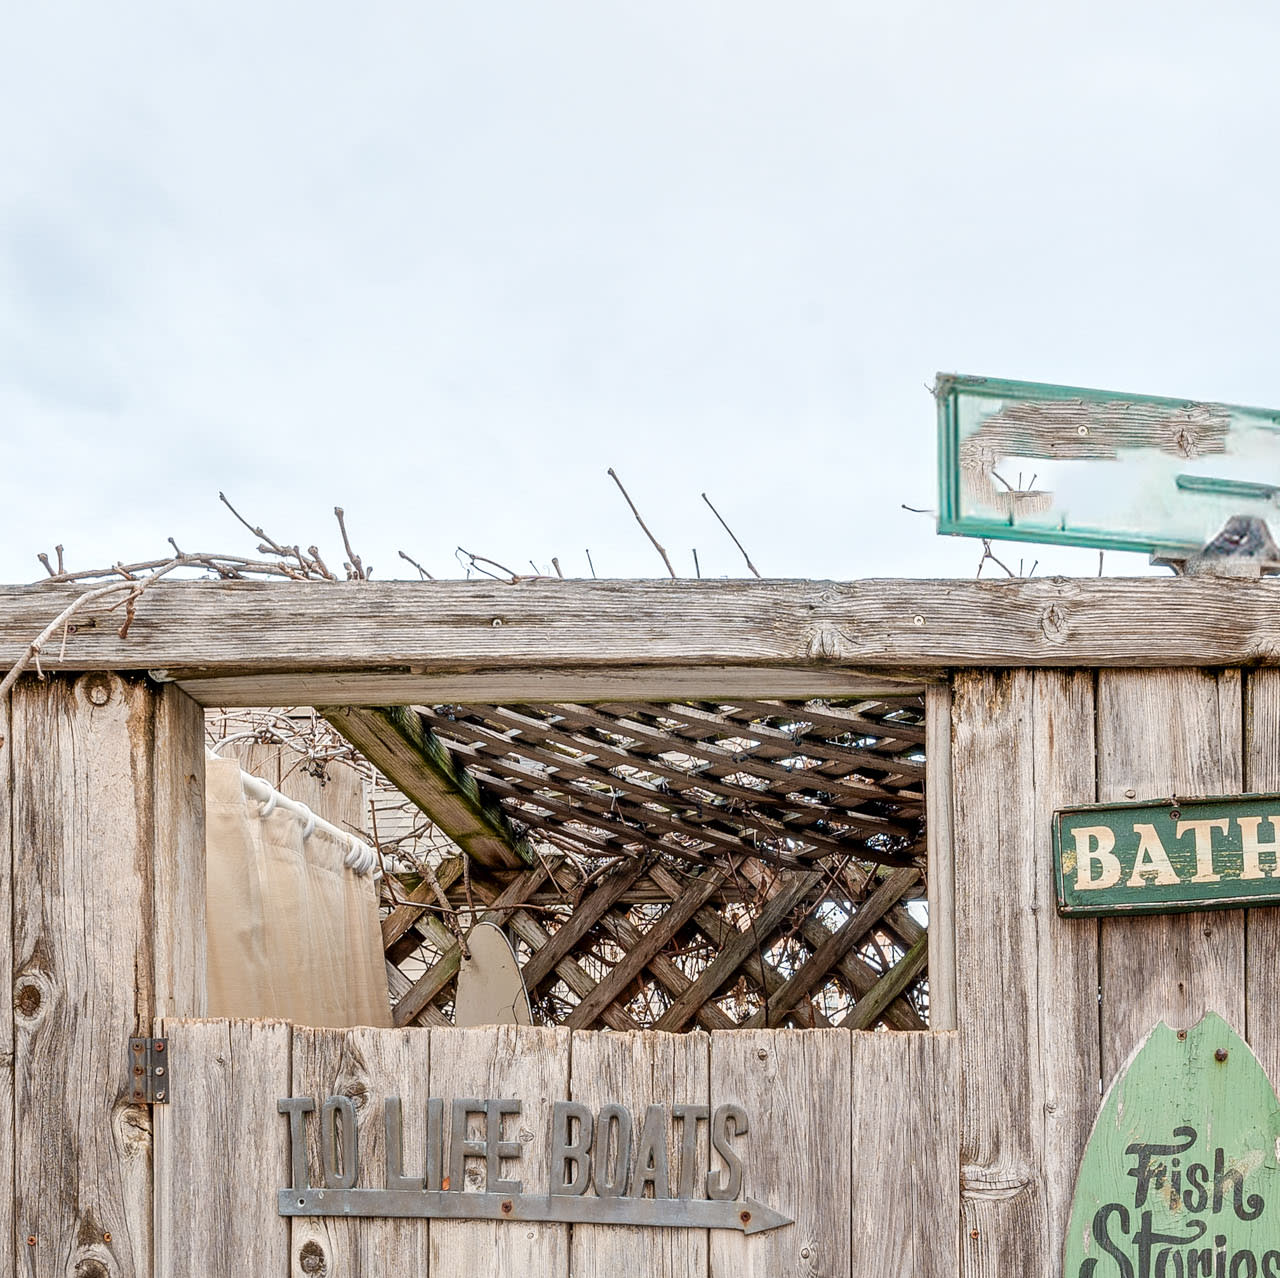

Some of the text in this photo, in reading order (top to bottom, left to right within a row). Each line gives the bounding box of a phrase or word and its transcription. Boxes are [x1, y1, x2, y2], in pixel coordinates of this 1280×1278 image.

[277, 1095, 750, 1201] TO LIFE BOATS
[1124, 1125, 1265, 1221] Fish
